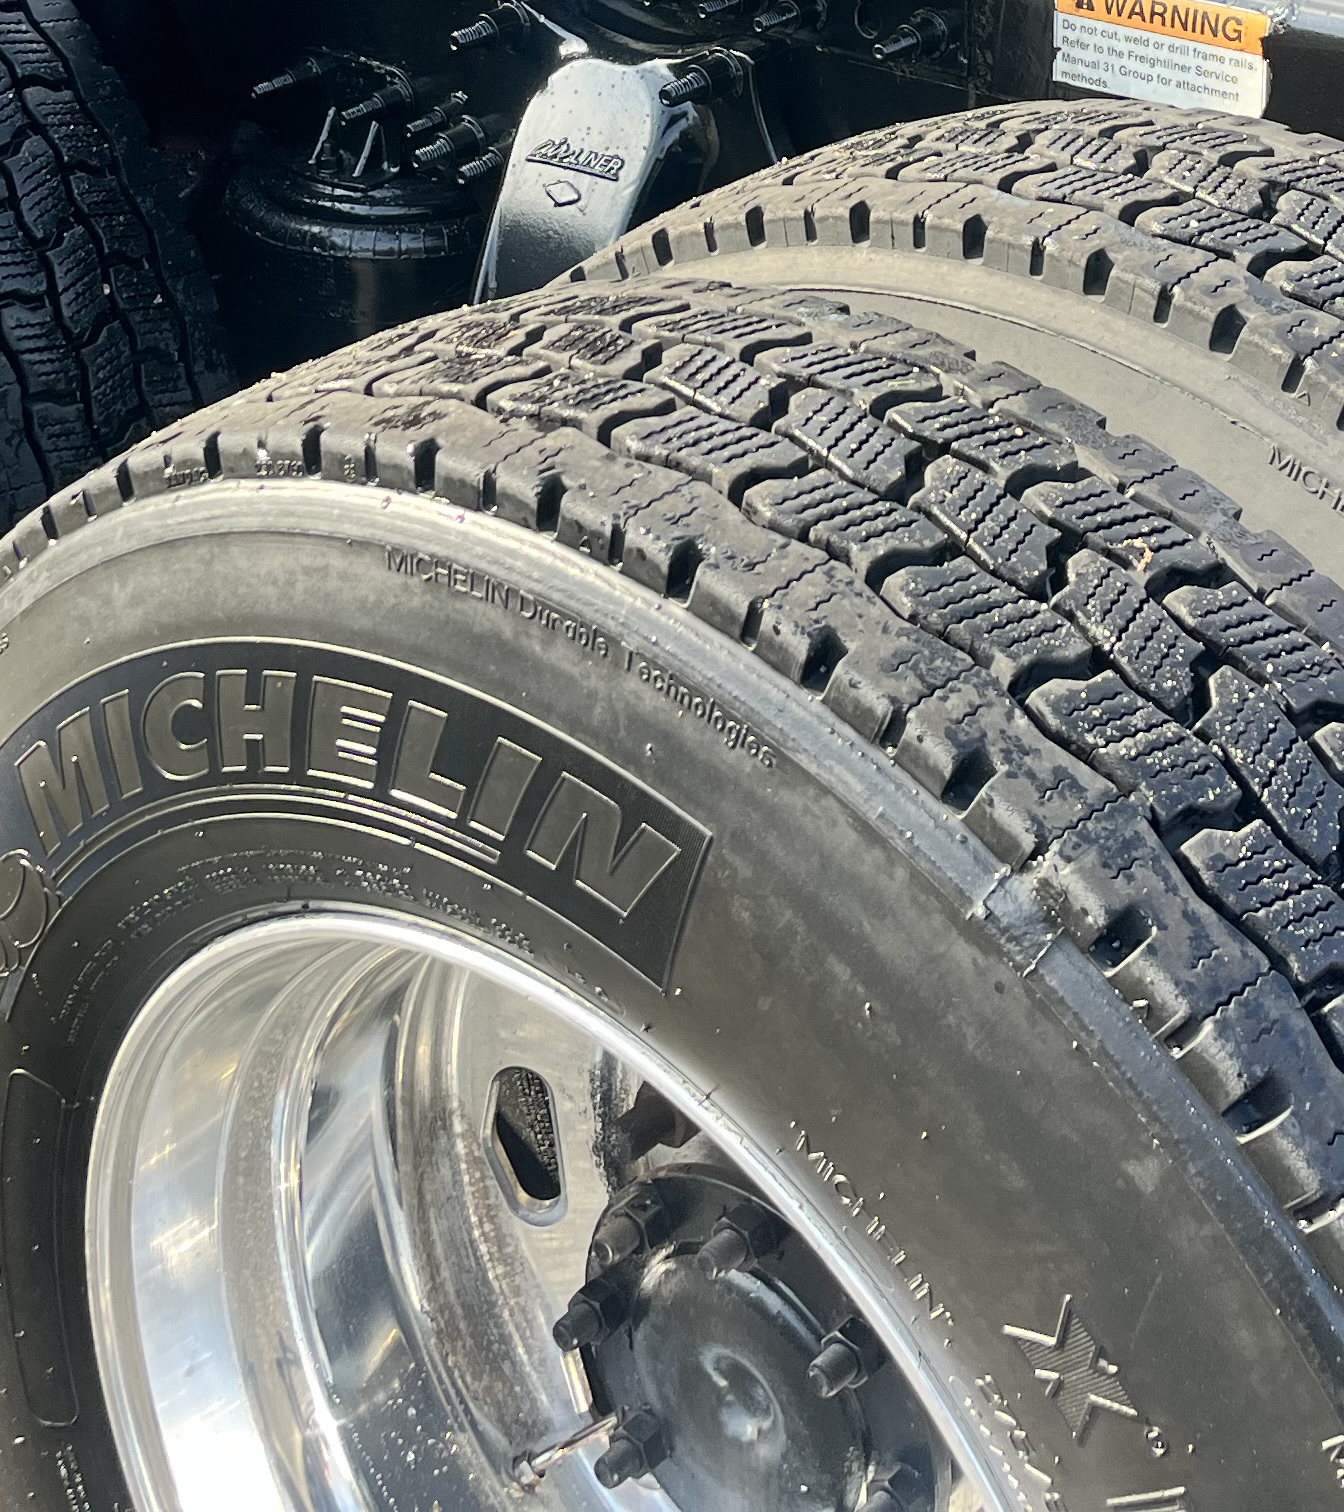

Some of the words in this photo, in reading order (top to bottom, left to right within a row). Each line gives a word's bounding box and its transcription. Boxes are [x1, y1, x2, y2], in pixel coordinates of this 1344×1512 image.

[1062, 19, 1077, 32] Do
[1080, 22, 1097, 36] not
[1100, 28, 1121, 42] cut,
[1124, 32, 1150, 48] weld
[1153, 40, 1165, 50] or
[1168, 41, 1190, 57] drill
[1193, 47, 1226, 65] frame
[1228, 54, 1258, 72] rails.
[1062, 36, 1091, 52] Refer
[1094, 42, 1104, 55] to
[1108, 44, 1125, 58] the
[1128, 50, 1191, 76] Freightliner
[1195, 64, 1239, 85] Service
[1061, 70, 1110, 90] methods.
[1062, 52, 1100, 72] Manual
[1103, 61, 1116, 73] 31
[1119, 64, 1154, 84] Group
[1157, 72, 1172, 86] for
[1176, 77, 1240, 102] attachment
[386, 546, 510, 612] MICHELIN
[517, 589, 610, 658] Durable
[621, 640, 777, 768] Technologies
[16, 669, 680, 919] MICHELIN
